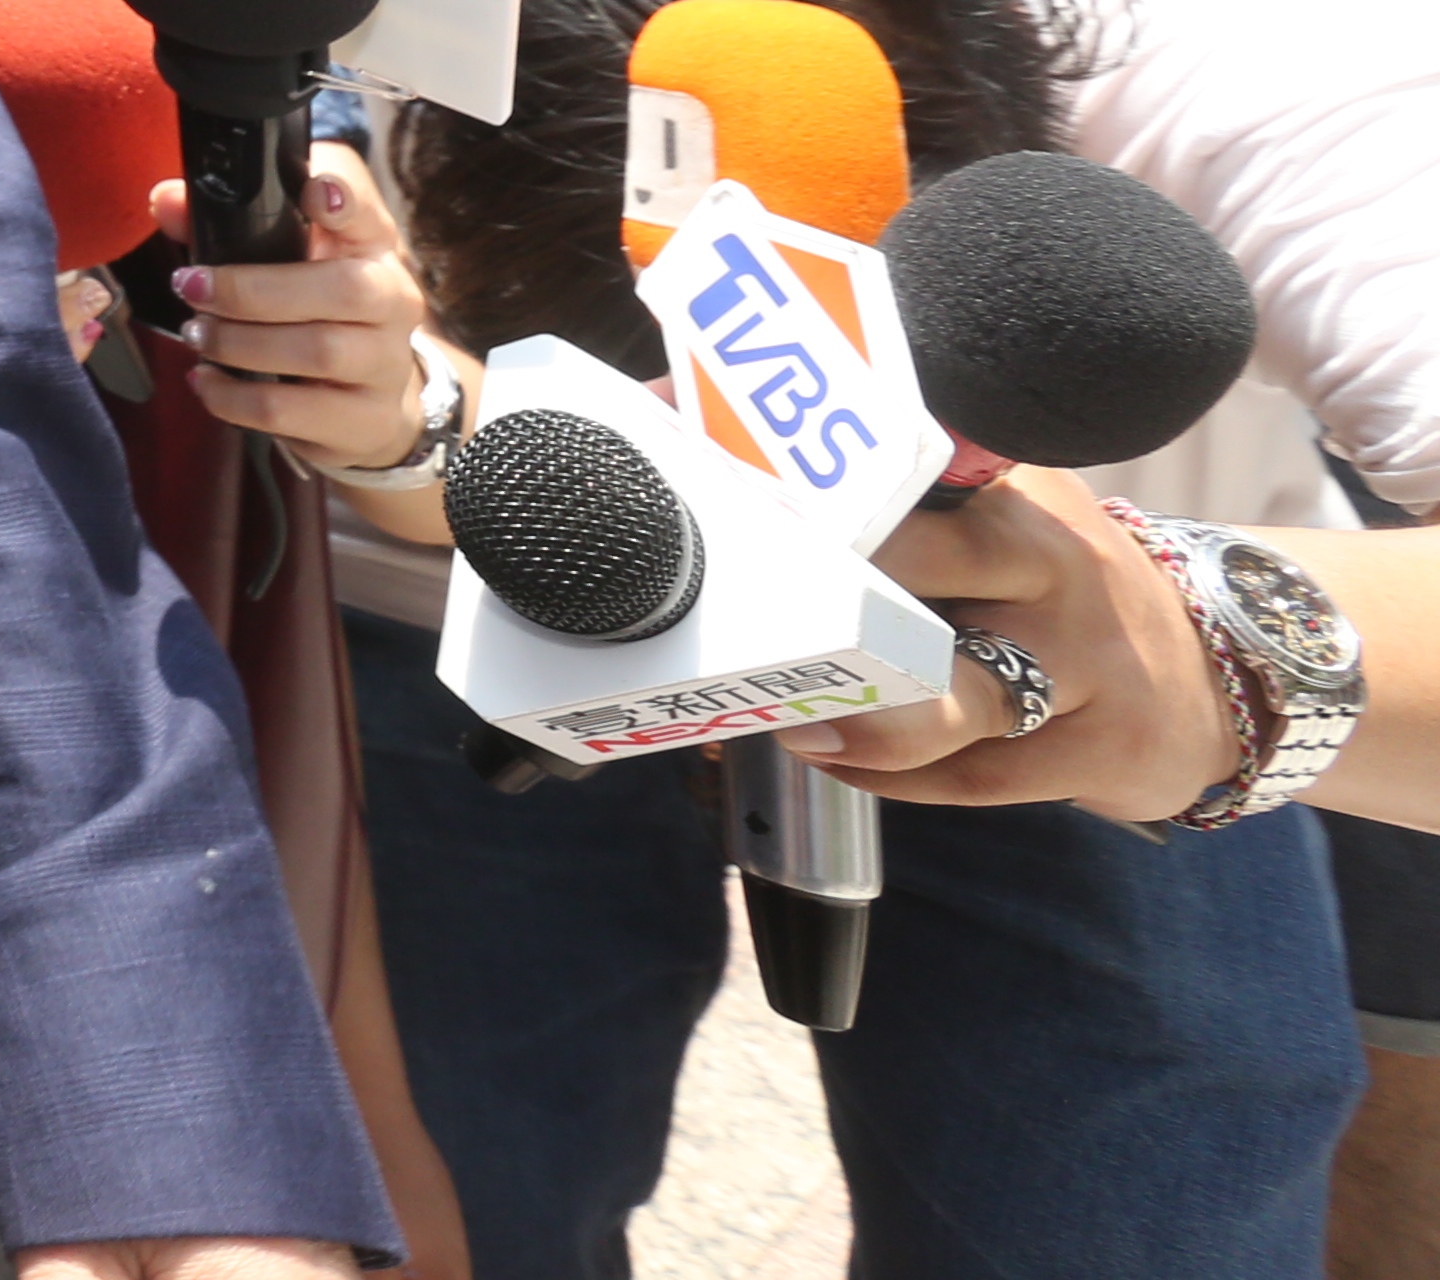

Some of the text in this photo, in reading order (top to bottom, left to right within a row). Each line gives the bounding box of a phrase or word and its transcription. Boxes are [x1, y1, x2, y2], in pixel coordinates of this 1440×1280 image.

[688, 233, 879, 490] TVBS
[536, 660, 867, 740] 壹新聞
